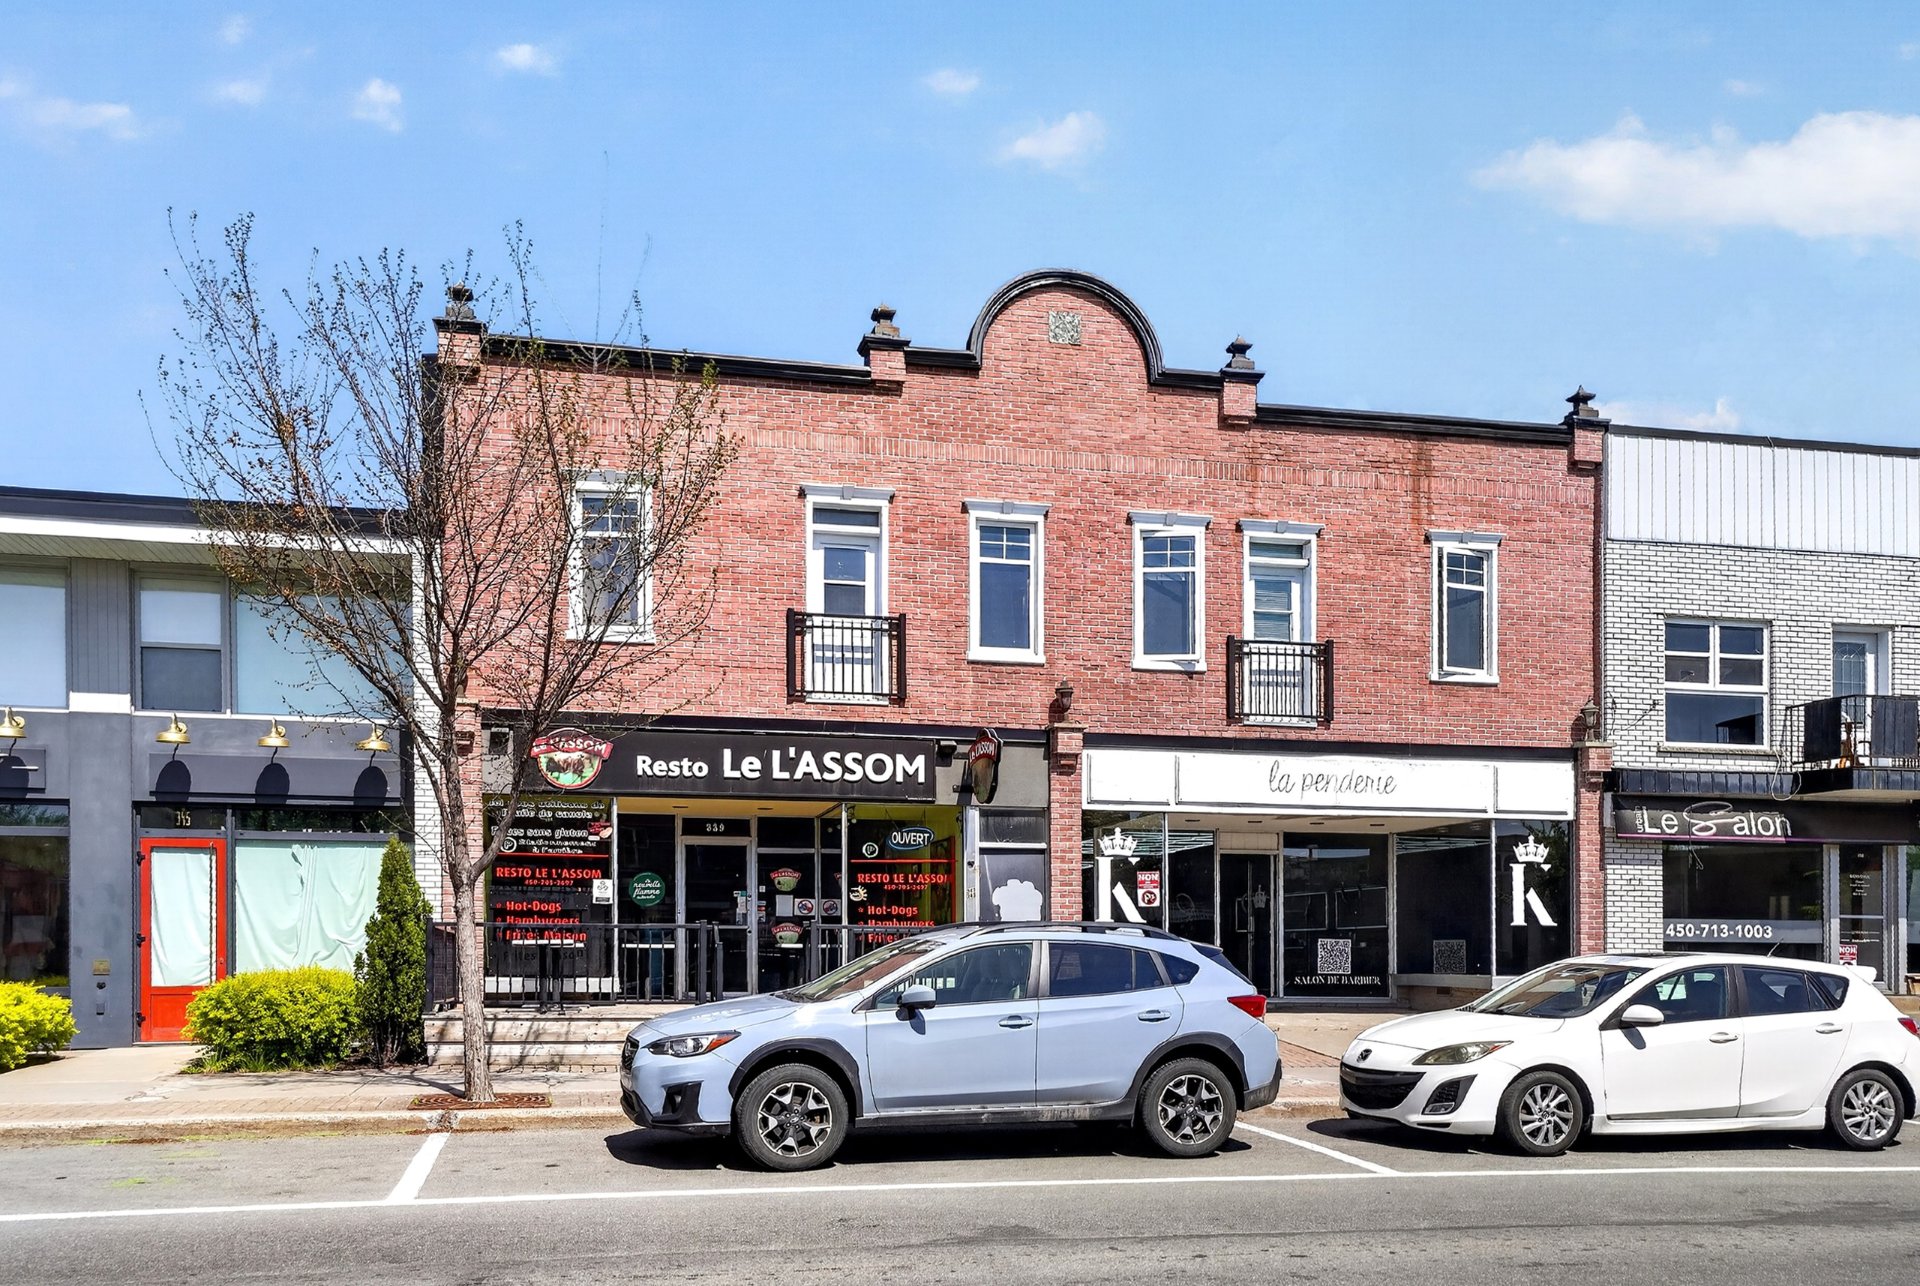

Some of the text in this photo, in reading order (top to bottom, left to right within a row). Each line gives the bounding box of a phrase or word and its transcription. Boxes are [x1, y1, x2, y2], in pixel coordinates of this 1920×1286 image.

[636, 746, 926, 783] Resto Le L'ASSOM
[1268, 760, 1398, 801] la penderie
[1642, 801, 1792, 836] Le Salon
[526, 828, 552, 837] sans
[554, 827, 589, 839] gluten
[706, 822, 725, 832] 339
[891, 831, 930, 846] OUVERT
[496, 867, 602, 879] RESTO LE L'ASSOM
[857, 873, 889, 883] RESTO
[894, 874, 904, 883] LE
[506, 900, 562, 914] Hot-Dogs
[867, 905, 918, 917] Hot-Dogs
[544, 930, 587, 942] Maison
[1665, 923, 1773, 939] 450-713-1003
[1839, 946, 1856, 954] NON
[1294, 975, 1381, 986] SALON DE BARBIER
